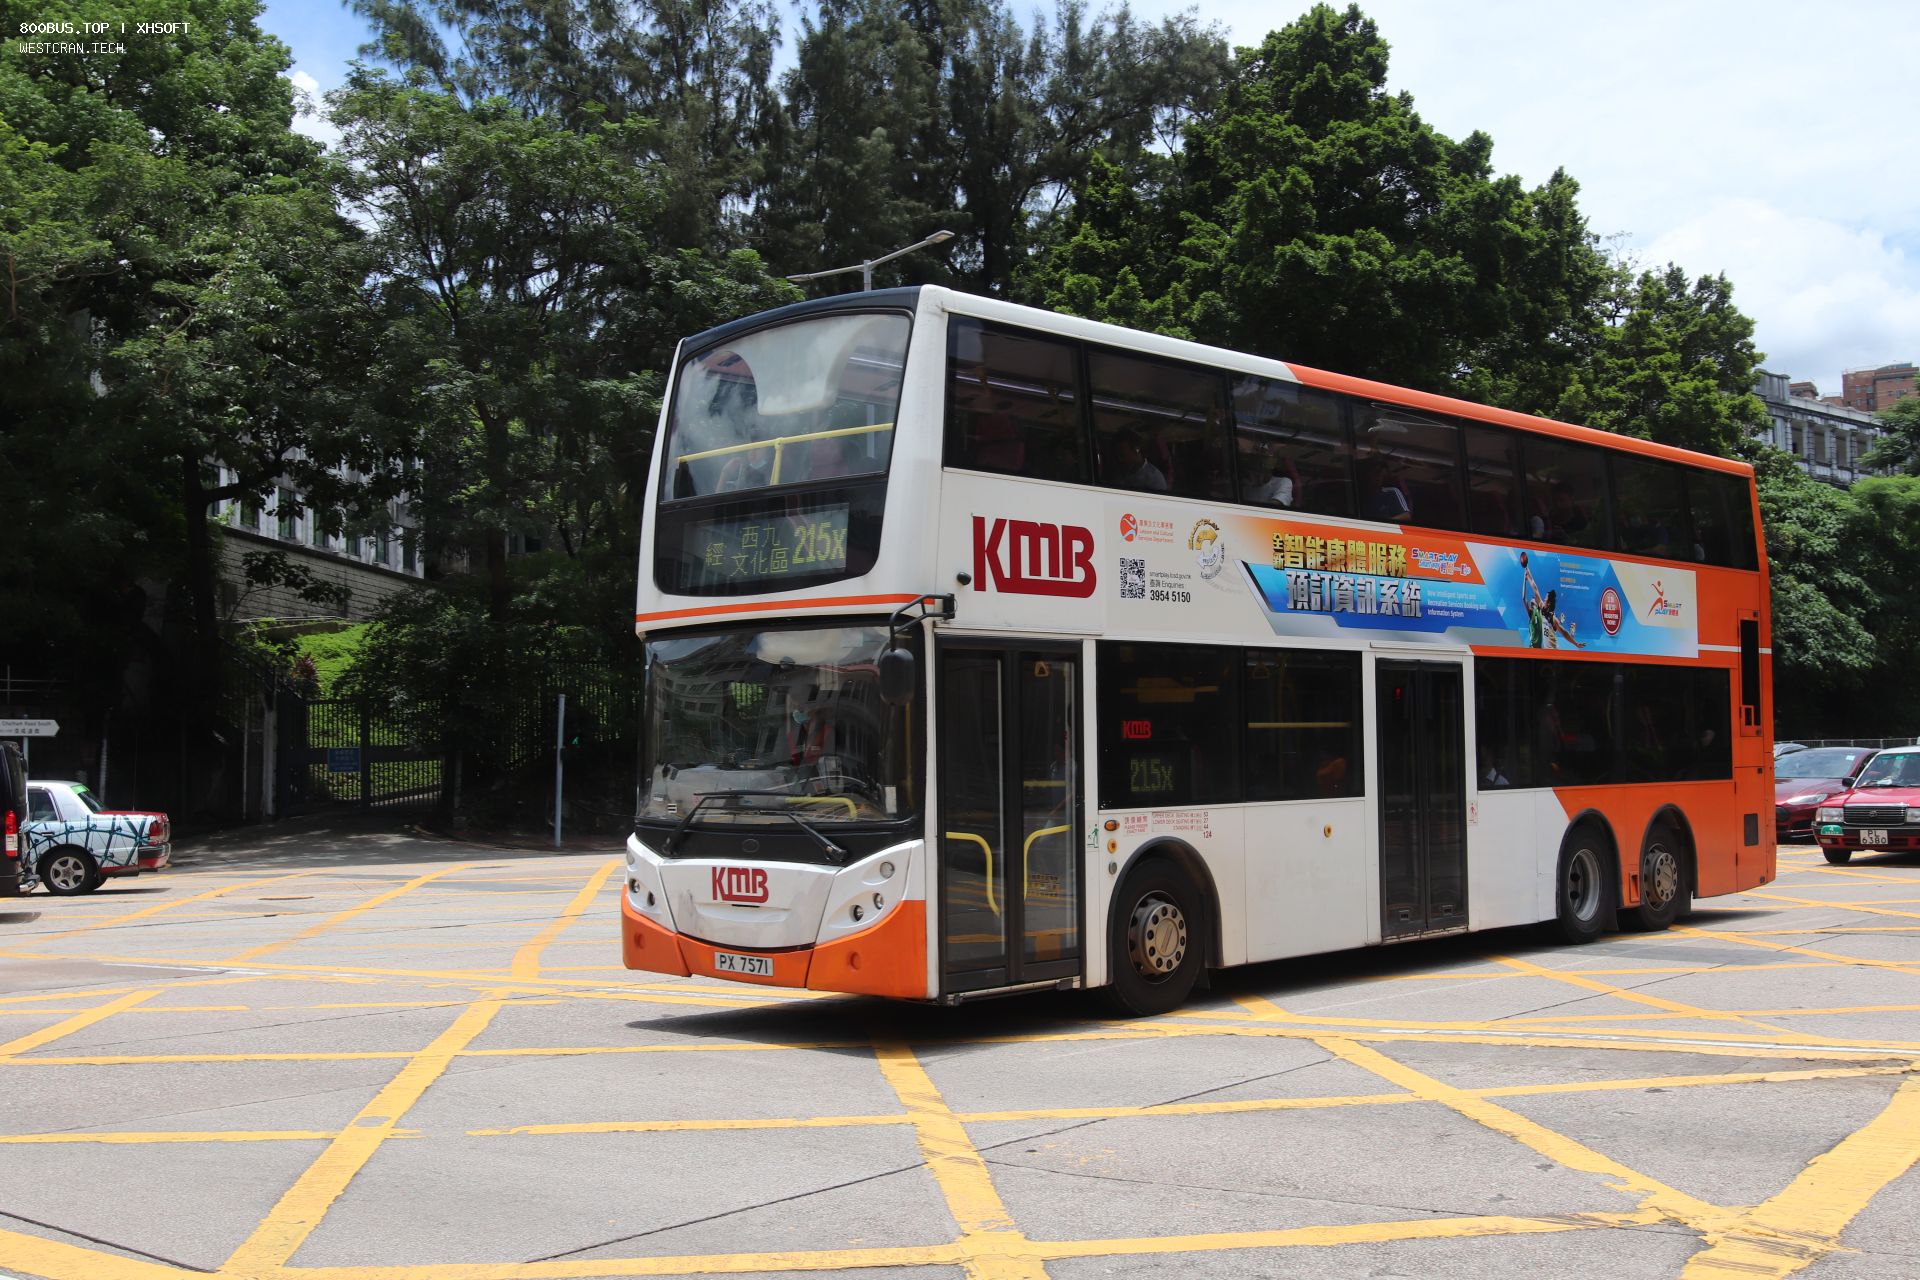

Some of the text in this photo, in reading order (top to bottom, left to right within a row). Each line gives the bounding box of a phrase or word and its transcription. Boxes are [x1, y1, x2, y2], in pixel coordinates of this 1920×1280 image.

[741, 523, 781, 550] 西九
[705, 542, 725, 566] 經
[729, 547, 789, 577] 文化區
[972, 515, 1097, 599] KMB
[1161, 580, 1184, 589] Enquiries
[1286, 570, 1422, 618] 預訂資訊系統
[1150, 589, 1191, 603] 3954 5150
[1123, 720, 1152, 739] KMB
[1203, 830, 1212, 839] 124
[1867, 829, 1879, 837] PL
[712, 866, 769, 904] KMB
[719, 954, 769, 975] PX 7571
